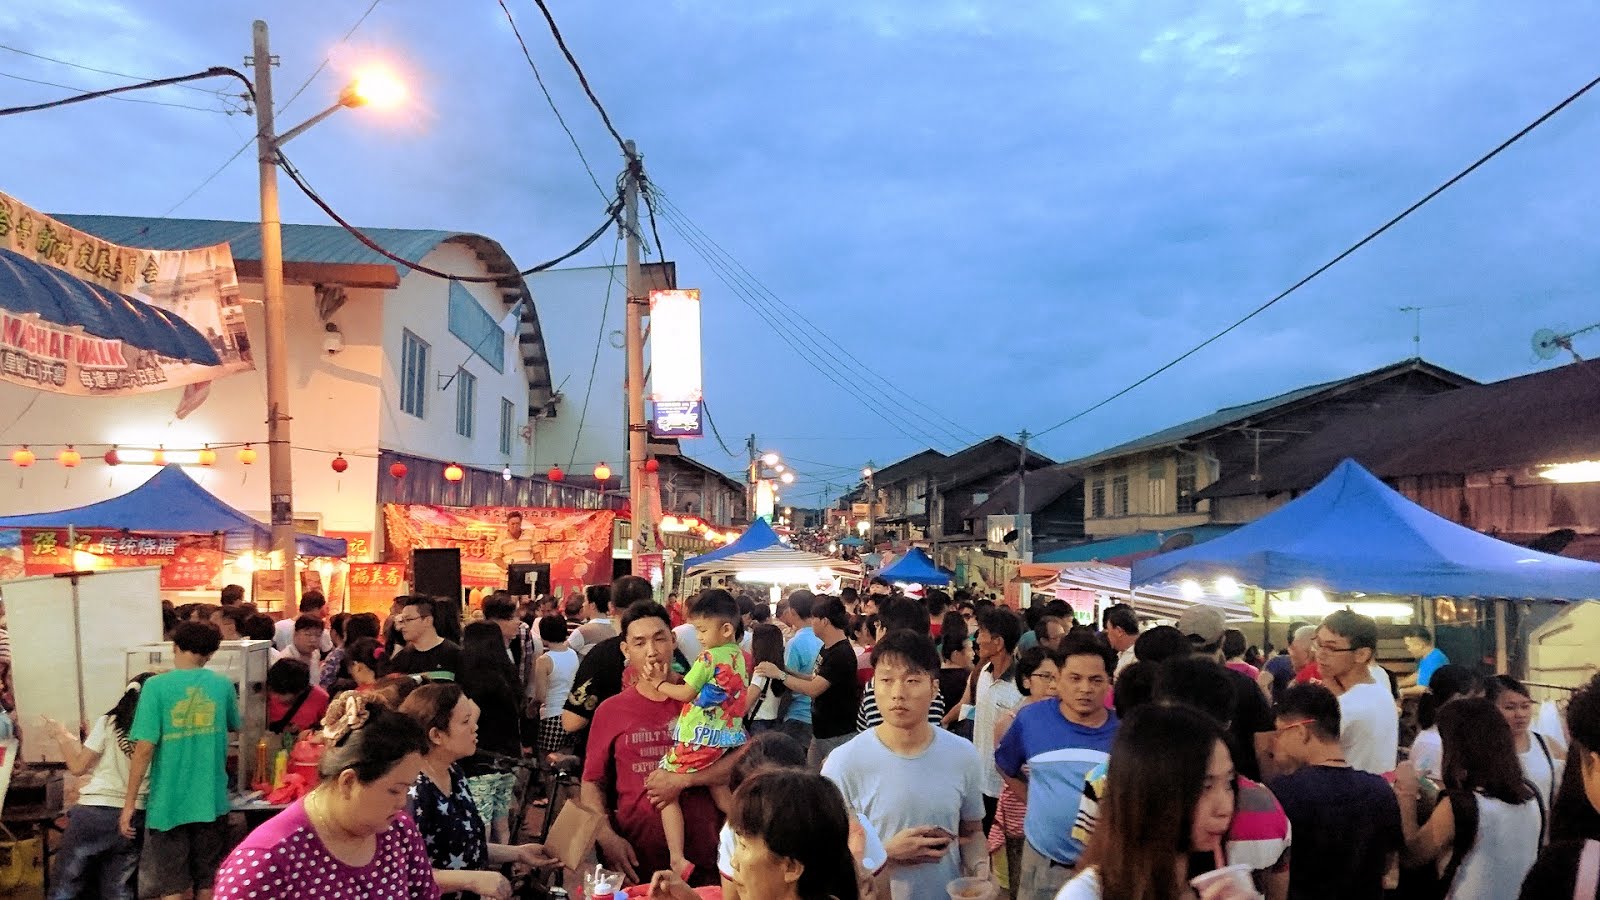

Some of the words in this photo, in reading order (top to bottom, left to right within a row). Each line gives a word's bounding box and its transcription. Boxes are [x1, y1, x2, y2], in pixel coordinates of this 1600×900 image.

[76, 338, 127, 366] WALK
[98, 535, 178, 556] 传统烧腊
[351, 566, 401, 585] 福美香
